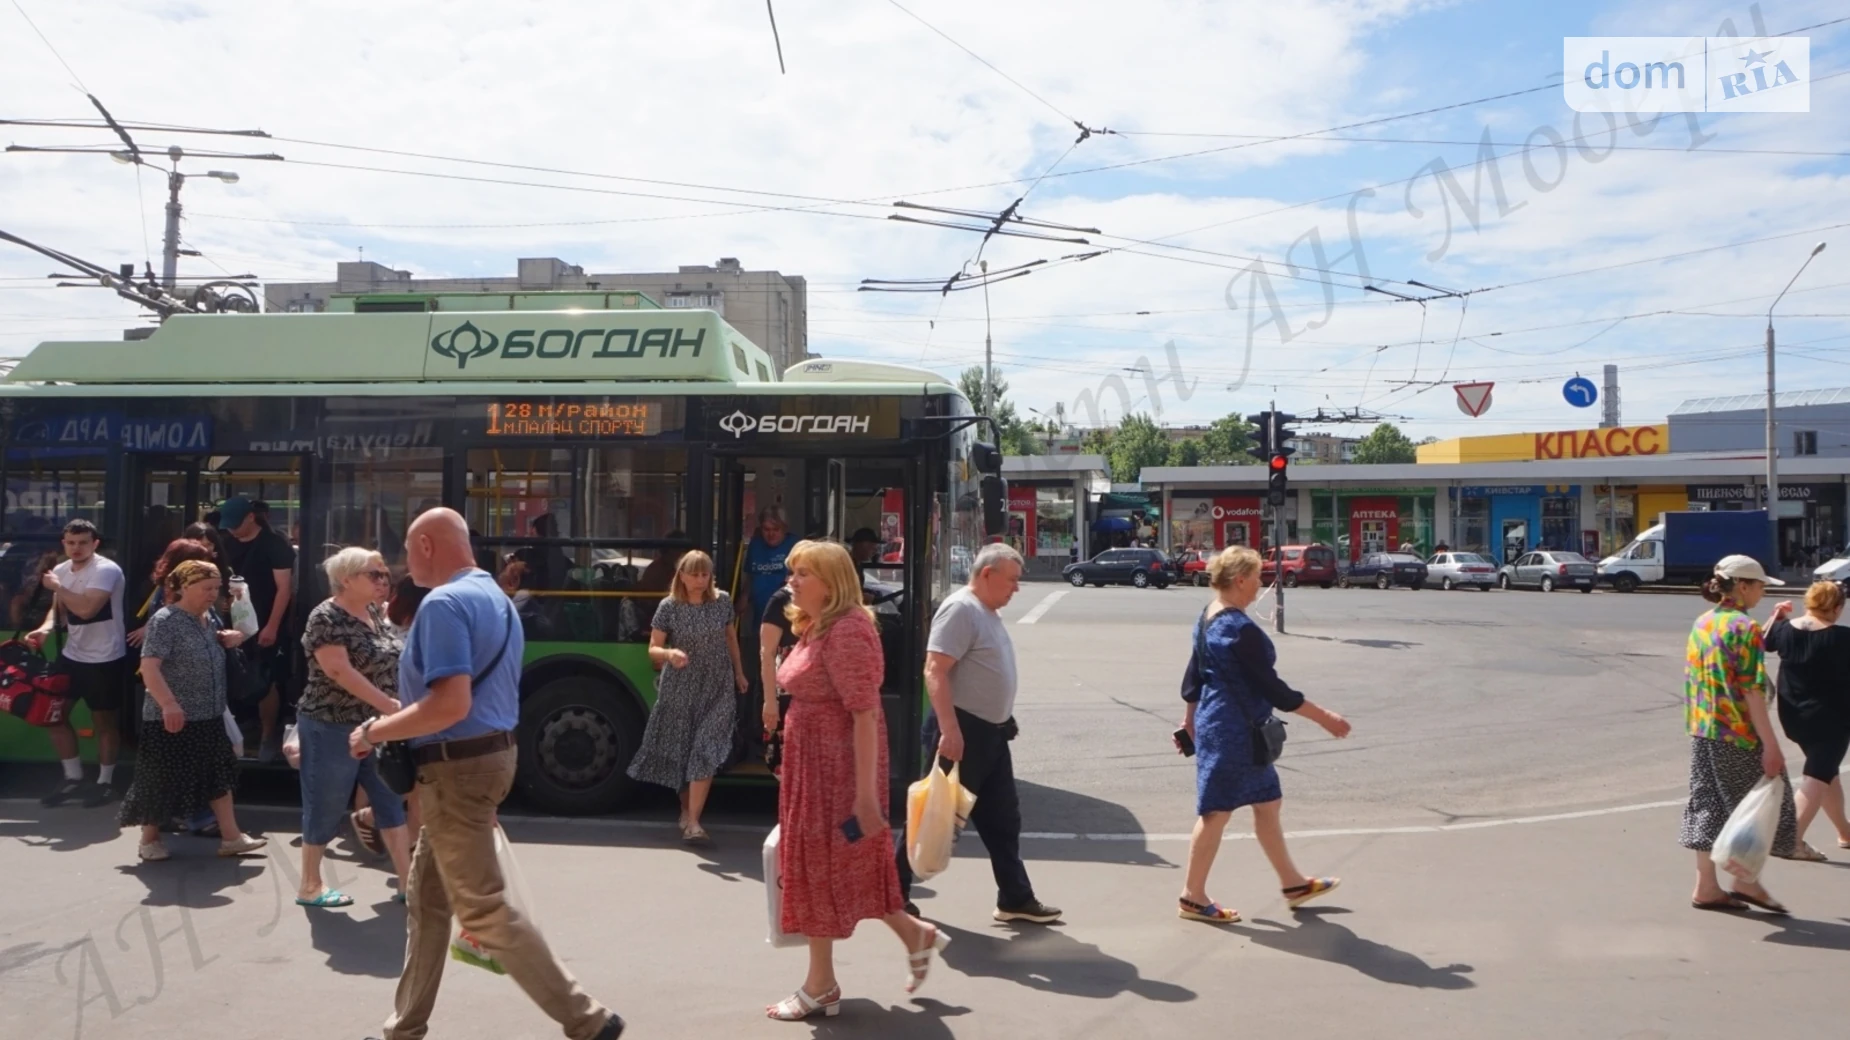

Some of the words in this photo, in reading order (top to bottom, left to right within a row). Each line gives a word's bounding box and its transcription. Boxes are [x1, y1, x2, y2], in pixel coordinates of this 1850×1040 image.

[500, 328, 706, 359] БОГДАН
[505, 403, 531, 418] 28
[486, 403, 501, 434] 1
[757, 415, 870, 433] БОГДАН
[579, 420, 645, 434] СПОРТУ
[1534, 426, 1660, 460] КЛАСС
[1697, 488, 1744, 499] ПИВНОЕ
[1226, 507, 1264, 516] vodafone
[1352, 510, 1397, 519] АПТЕКА
